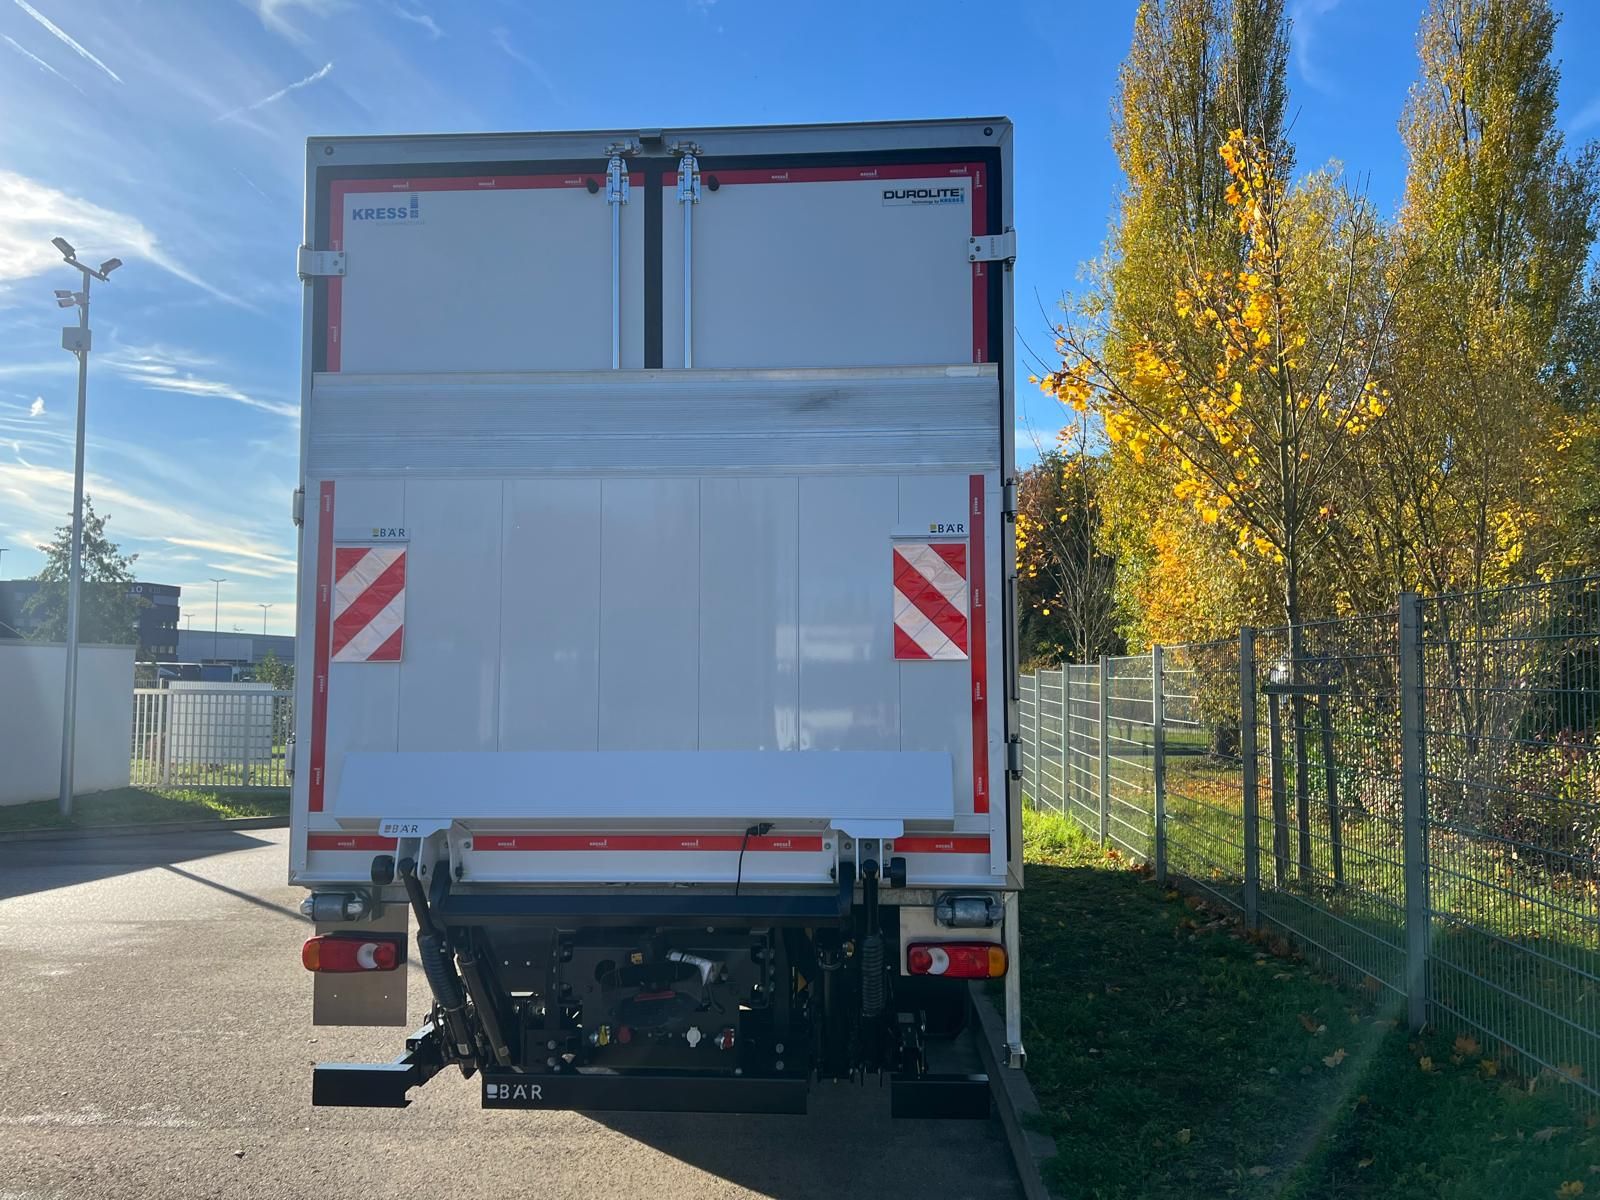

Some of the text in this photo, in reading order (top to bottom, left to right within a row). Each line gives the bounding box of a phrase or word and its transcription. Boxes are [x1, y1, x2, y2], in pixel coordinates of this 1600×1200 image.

[883, 188, 960, 199] DUROLITE
[352, 207, 408, 221] KRESS
[380, 527, 405, 538] BÄR
[938, 523, 965, 533] BÄR
[392, 824, 418, 833] BÄR
[499, 1083, 543, 1100] BÄR
